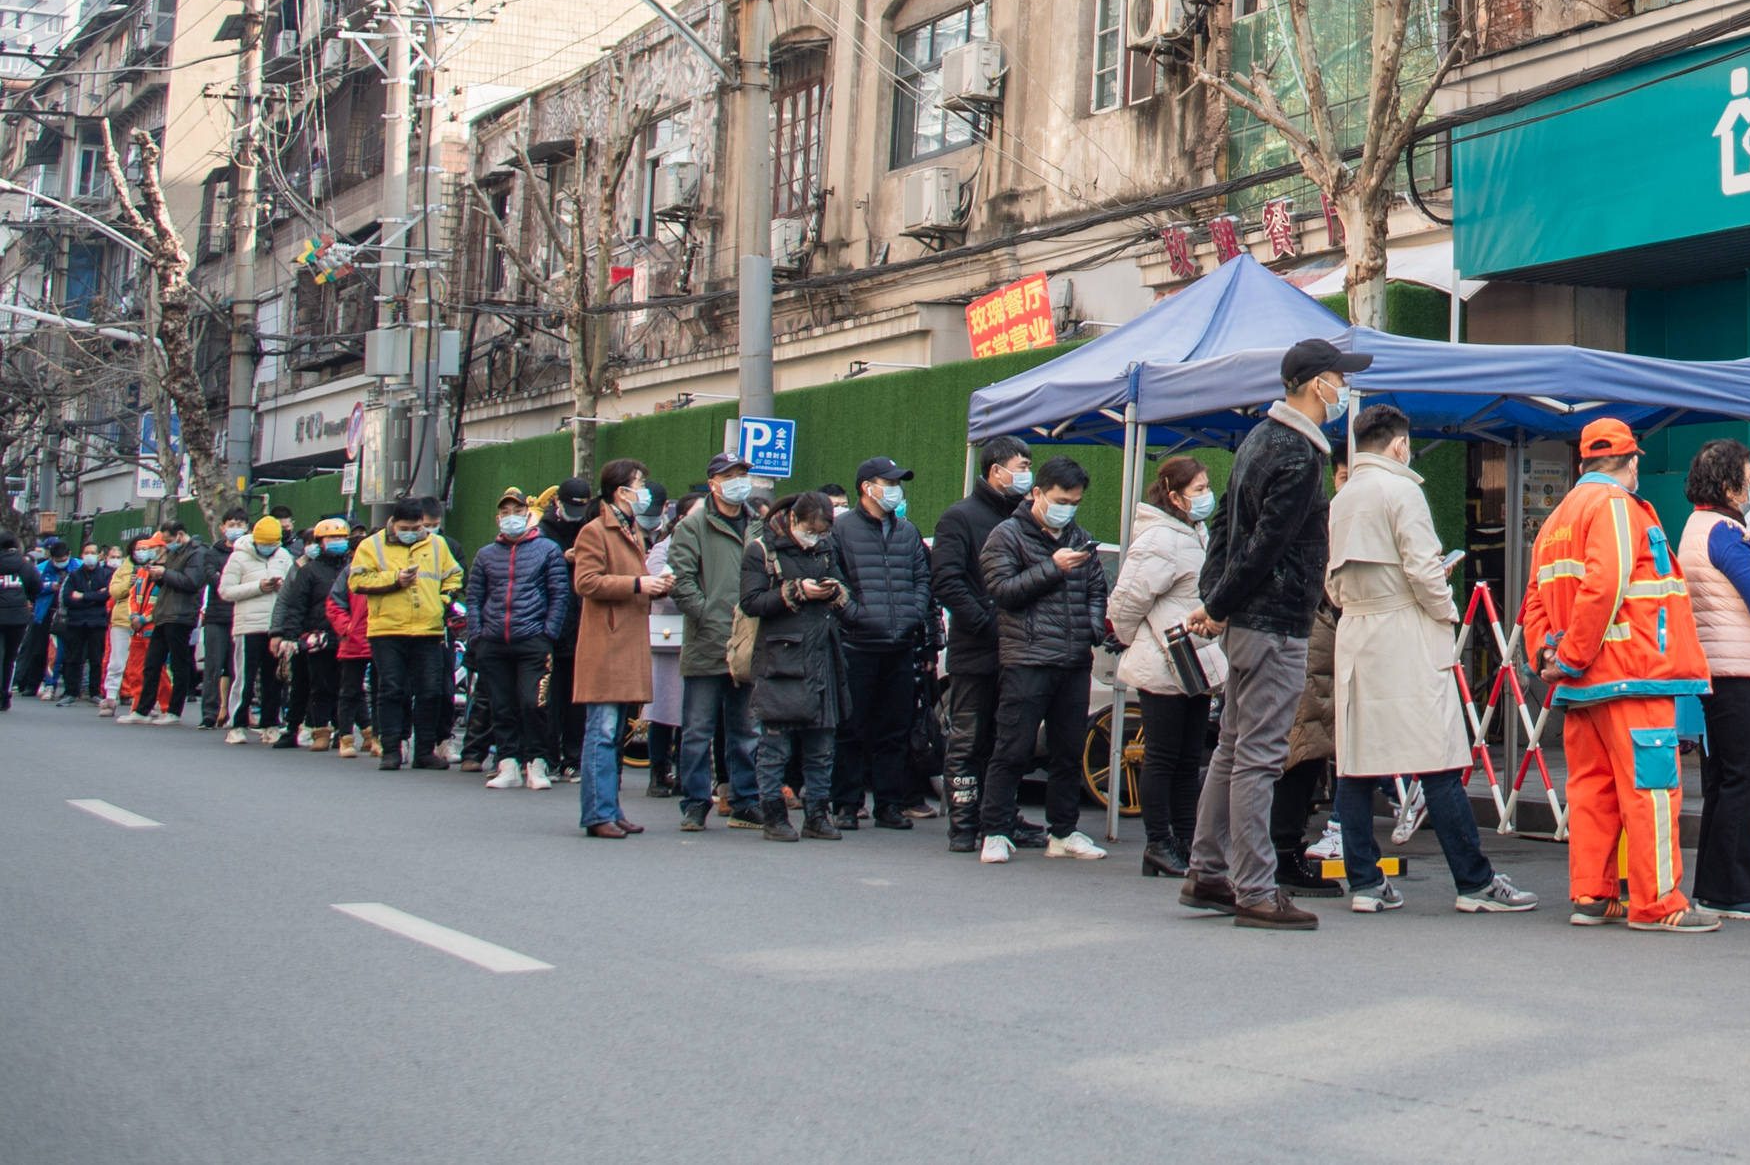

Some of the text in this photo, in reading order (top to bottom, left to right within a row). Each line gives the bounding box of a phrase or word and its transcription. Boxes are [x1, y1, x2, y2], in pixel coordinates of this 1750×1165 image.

[969, 279, 1044, 335] 玫瑰餐厅
[743, 421, 772, 464] P
[775, 427, 787, 450] 全天
